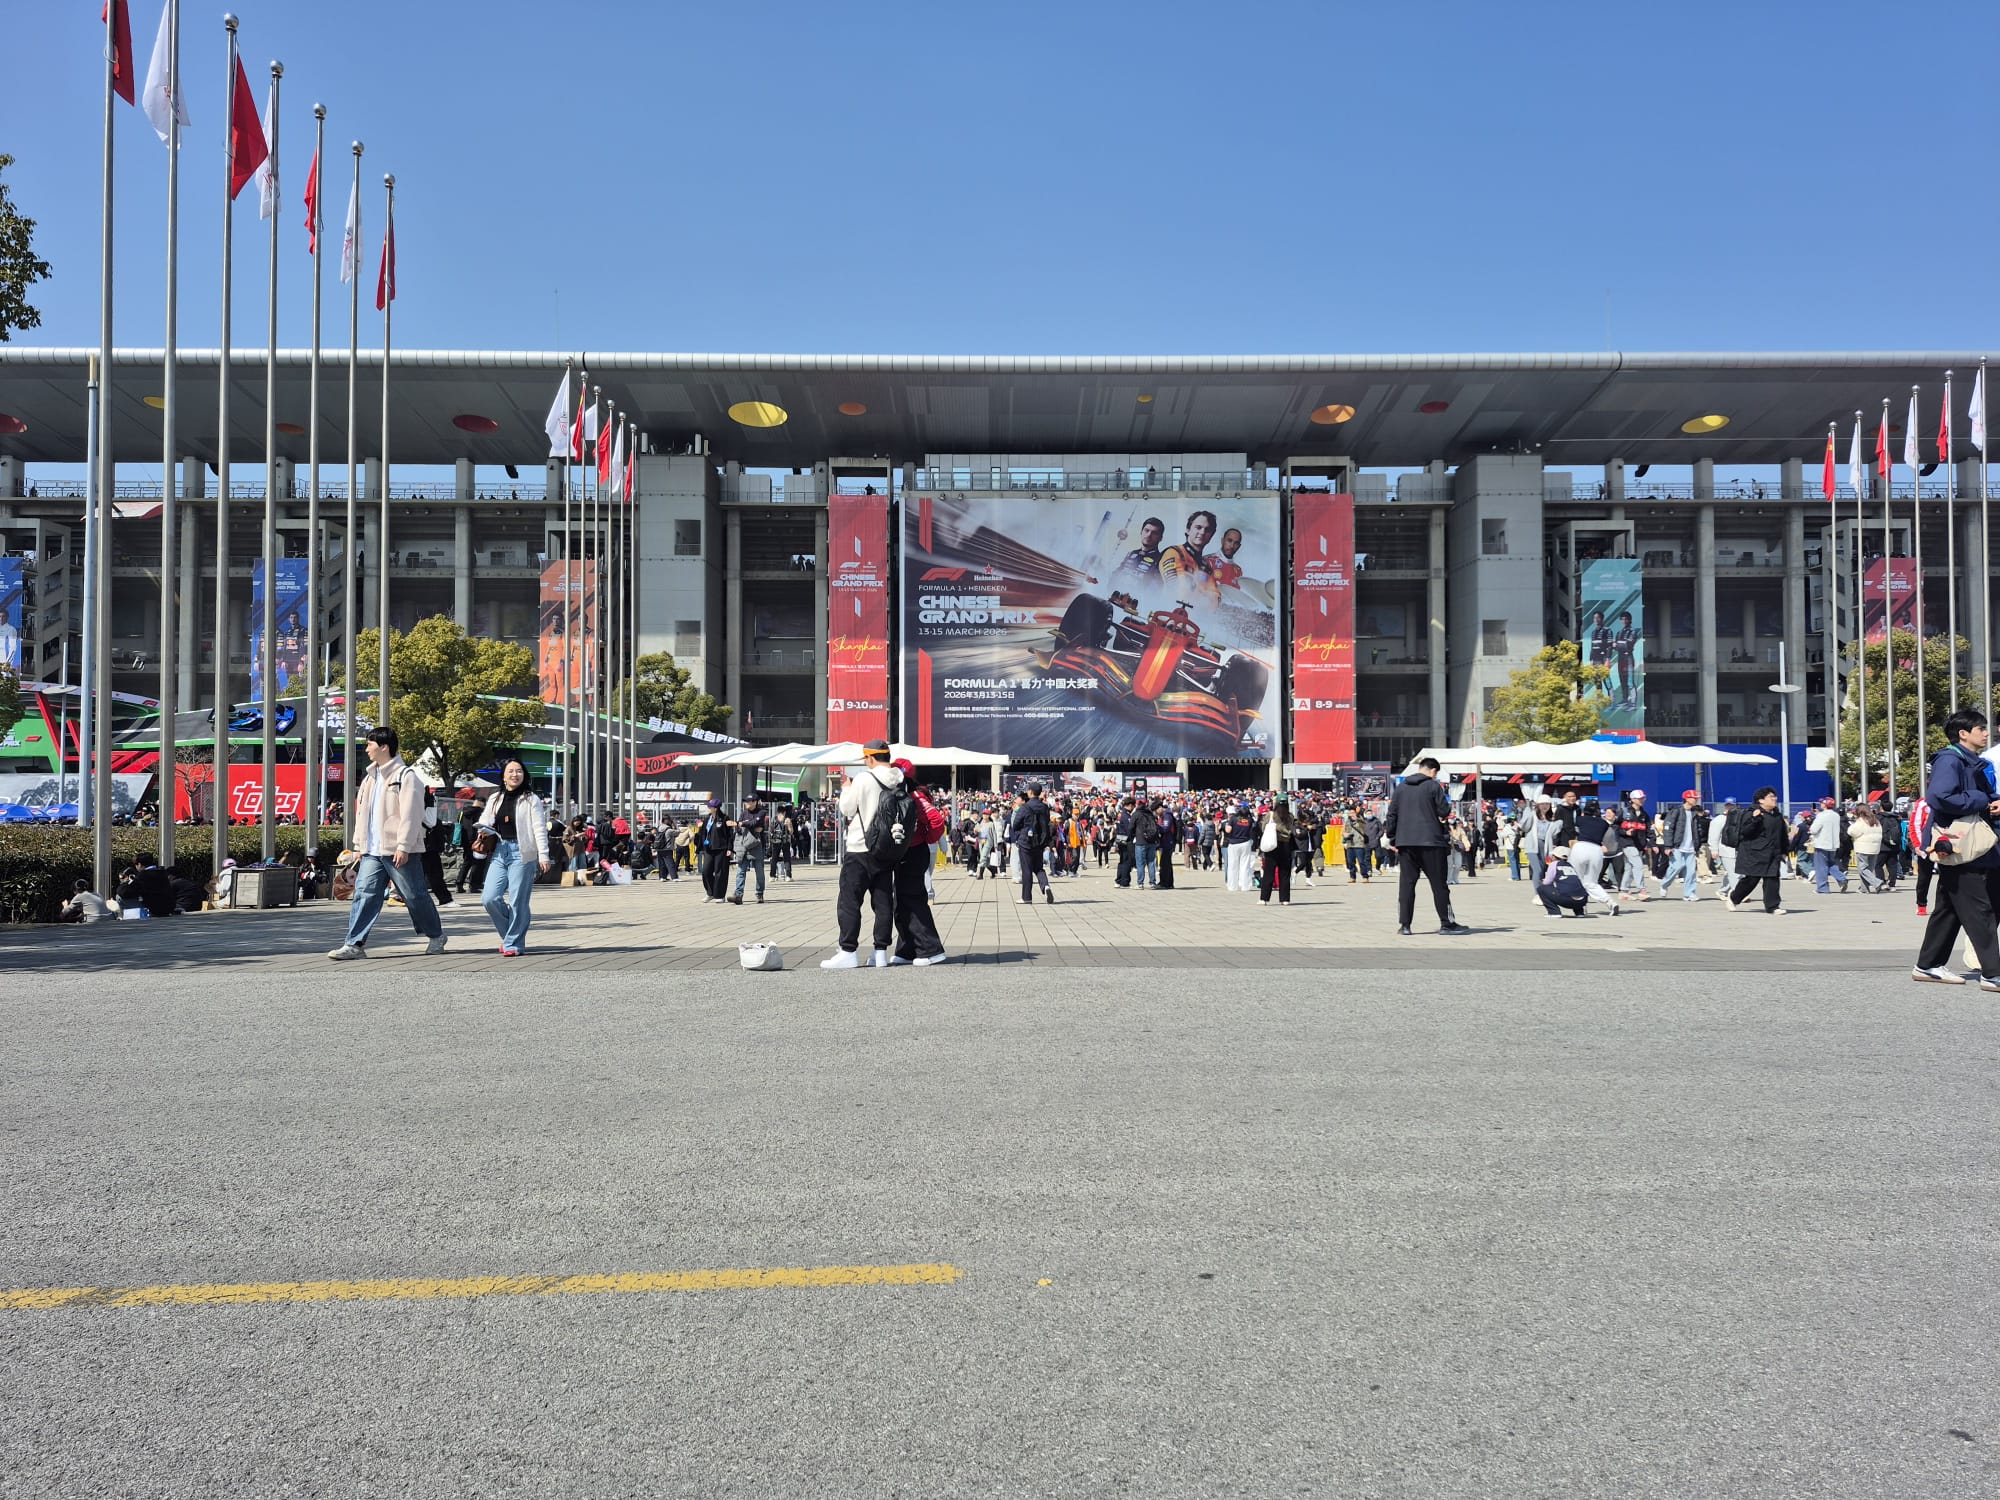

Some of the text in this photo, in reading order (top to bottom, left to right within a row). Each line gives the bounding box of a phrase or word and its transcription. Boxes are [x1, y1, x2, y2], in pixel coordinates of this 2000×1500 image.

[919, 596, 1000, 608] CHINESE
[919, 610, 1038, 624] GRAND PRIX
[832, 634, 884, 661] Shanghai
[1298, 633, 1350, 660] Shanghai
[944, 679, 1007, 688] FORMULA
[1046, 678, 1098, 689] 中国大奖赛
[832, 700, 842, 709] A
[847, 701, 869, 709] 9-10
[1299, 700, 1308, 708] A
[233, 781, 302, 815] tops
